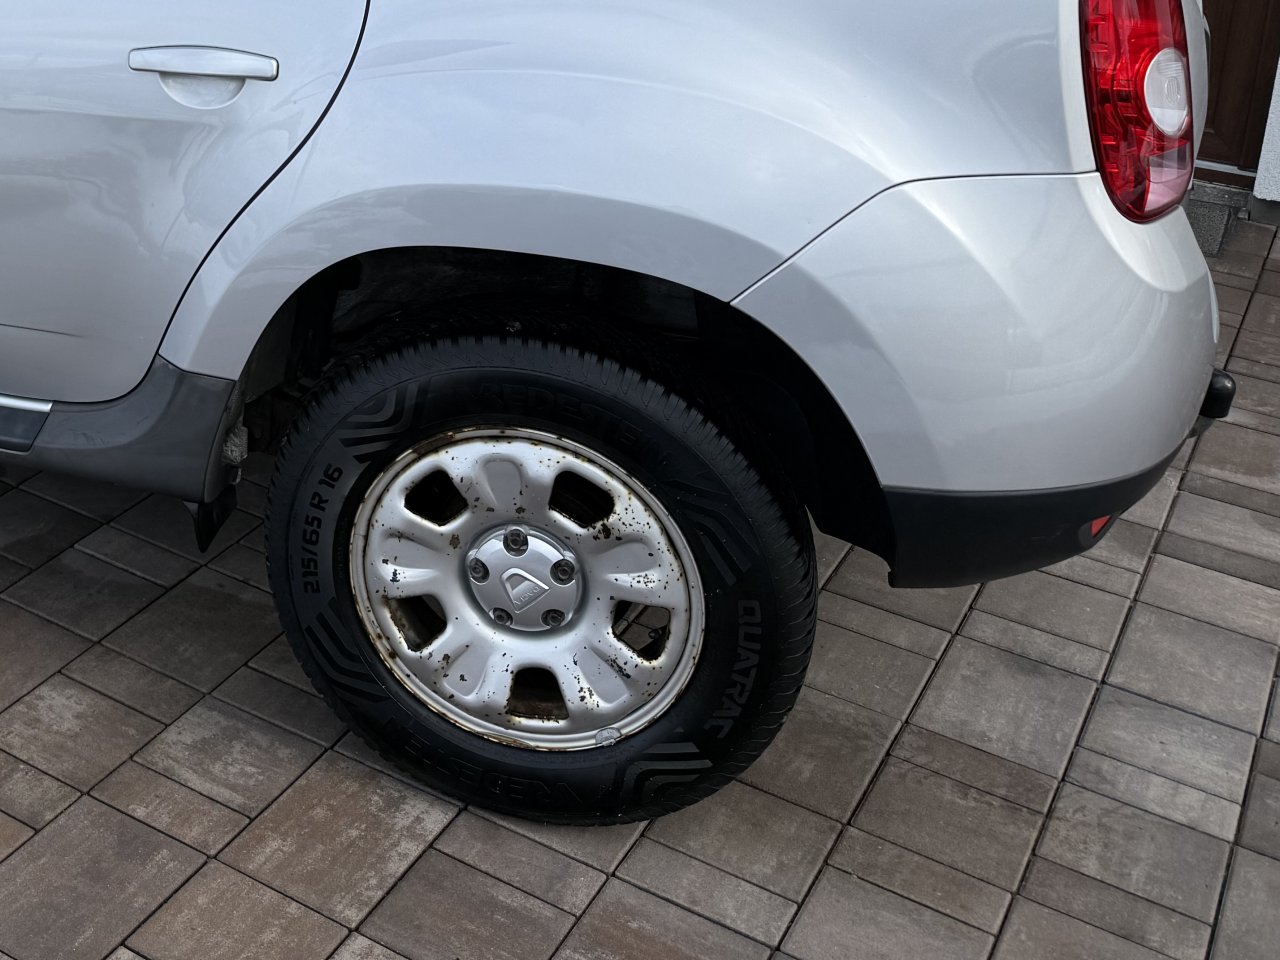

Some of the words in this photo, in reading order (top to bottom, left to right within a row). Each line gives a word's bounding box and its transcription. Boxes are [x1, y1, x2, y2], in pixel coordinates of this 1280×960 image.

[309, 491, 329, 512] R
[318, 463, 344, 489] 16
[301, 514, 323, 594] 215/65
[704, 599, 763, 739] QUATRAC
